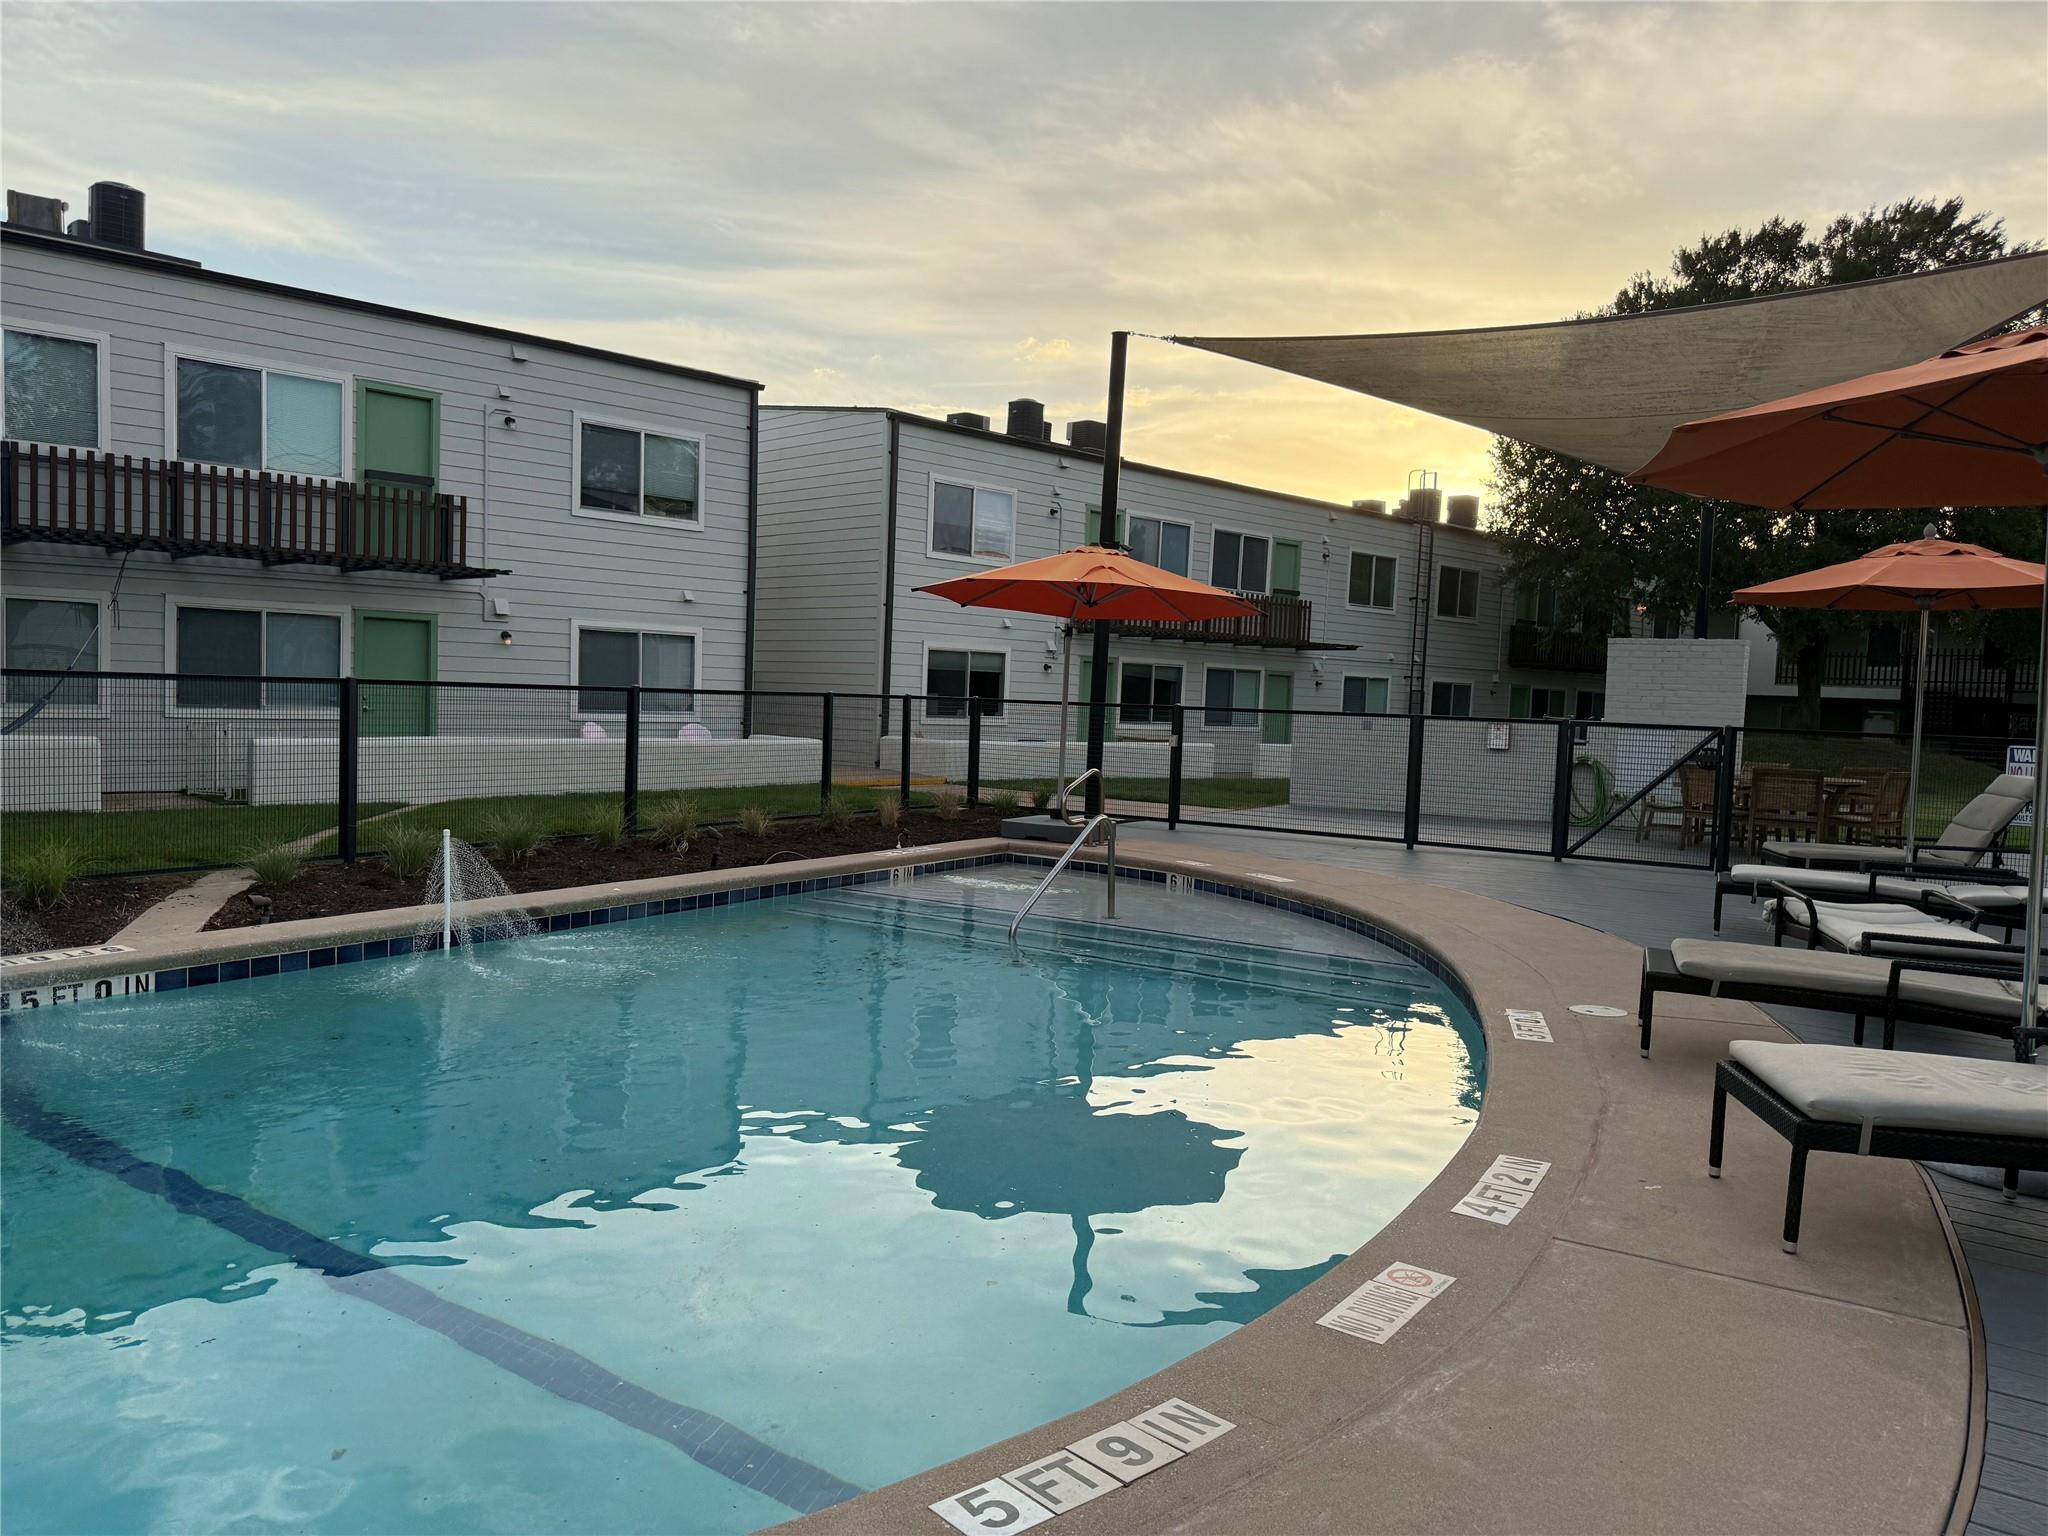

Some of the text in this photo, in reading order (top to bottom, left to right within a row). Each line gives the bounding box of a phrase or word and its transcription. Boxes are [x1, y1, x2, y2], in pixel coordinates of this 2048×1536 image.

[893, 868, 900, 879] 6
[1170, 874, 1193, 889] 6 IN
[21, 990, 39, 1008] 5
[52, 983, 84, 1006] FT
[125, 974, 150, 995] IN
[1461, 1157, 1543, 1217] 4 FT 2 IN
[1328, 1284, 1419, 1340] NO DIVING
[954, 1404, 1222, 1528] 5 FT 9 IN
